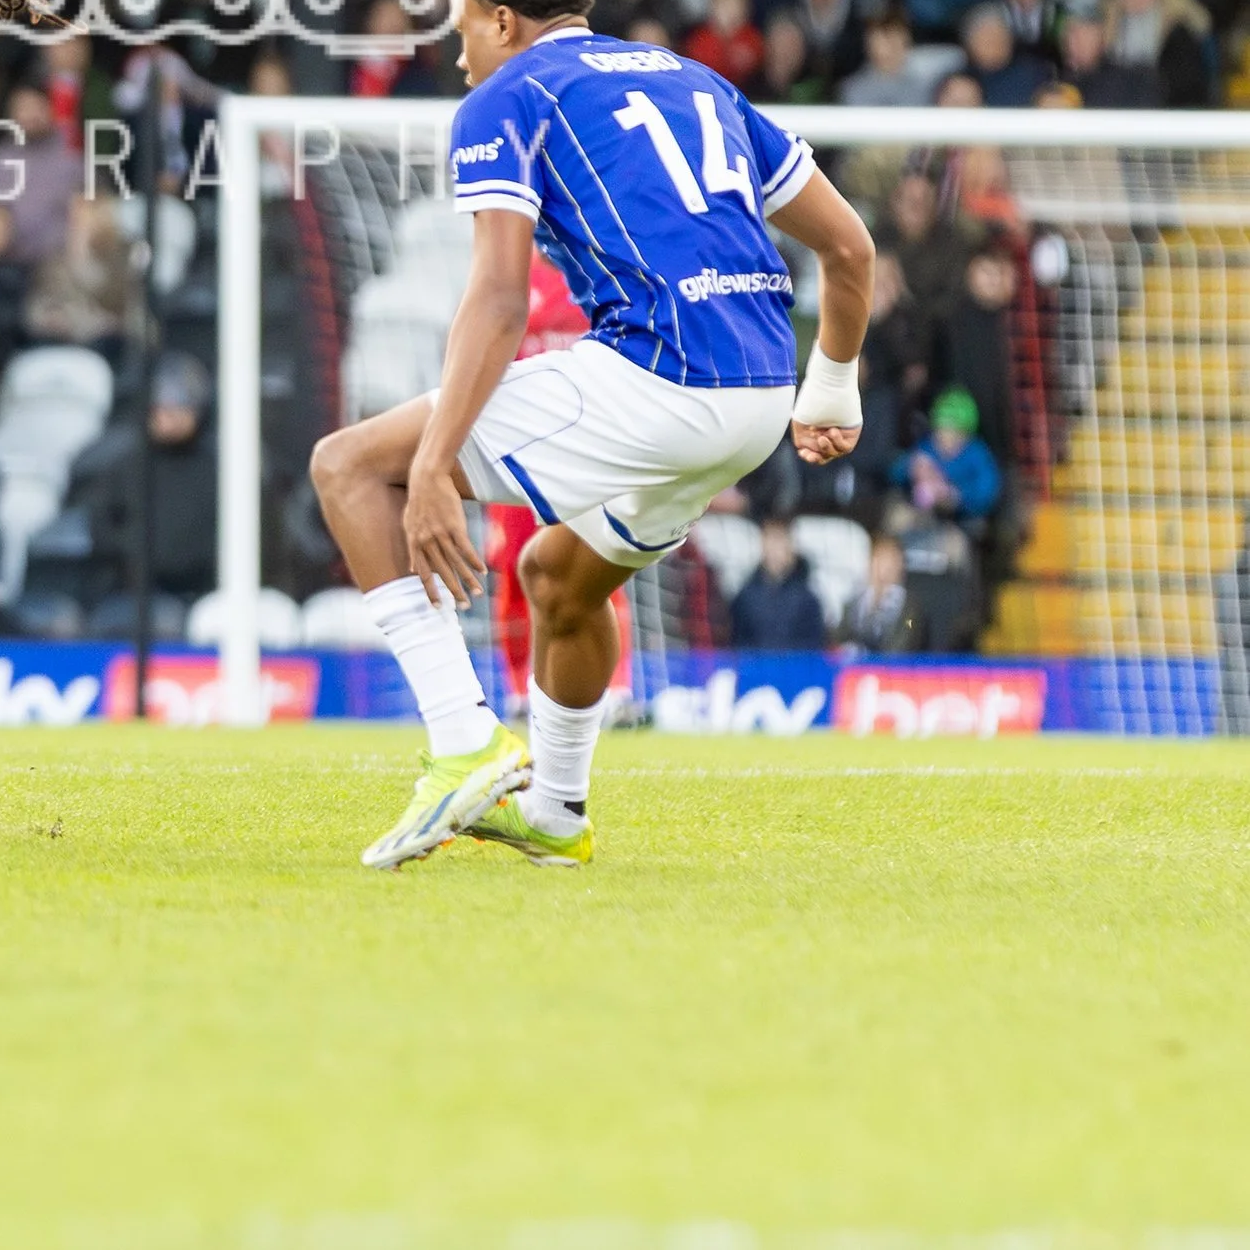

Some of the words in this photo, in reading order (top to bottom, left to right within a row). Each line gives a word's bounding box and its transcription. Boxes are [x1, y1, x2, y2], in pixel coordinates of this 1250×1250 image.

[613, 90, 756, 216] 14
[653, 669, 827, 735] sky
[854, 673, 1022, 738] bet
